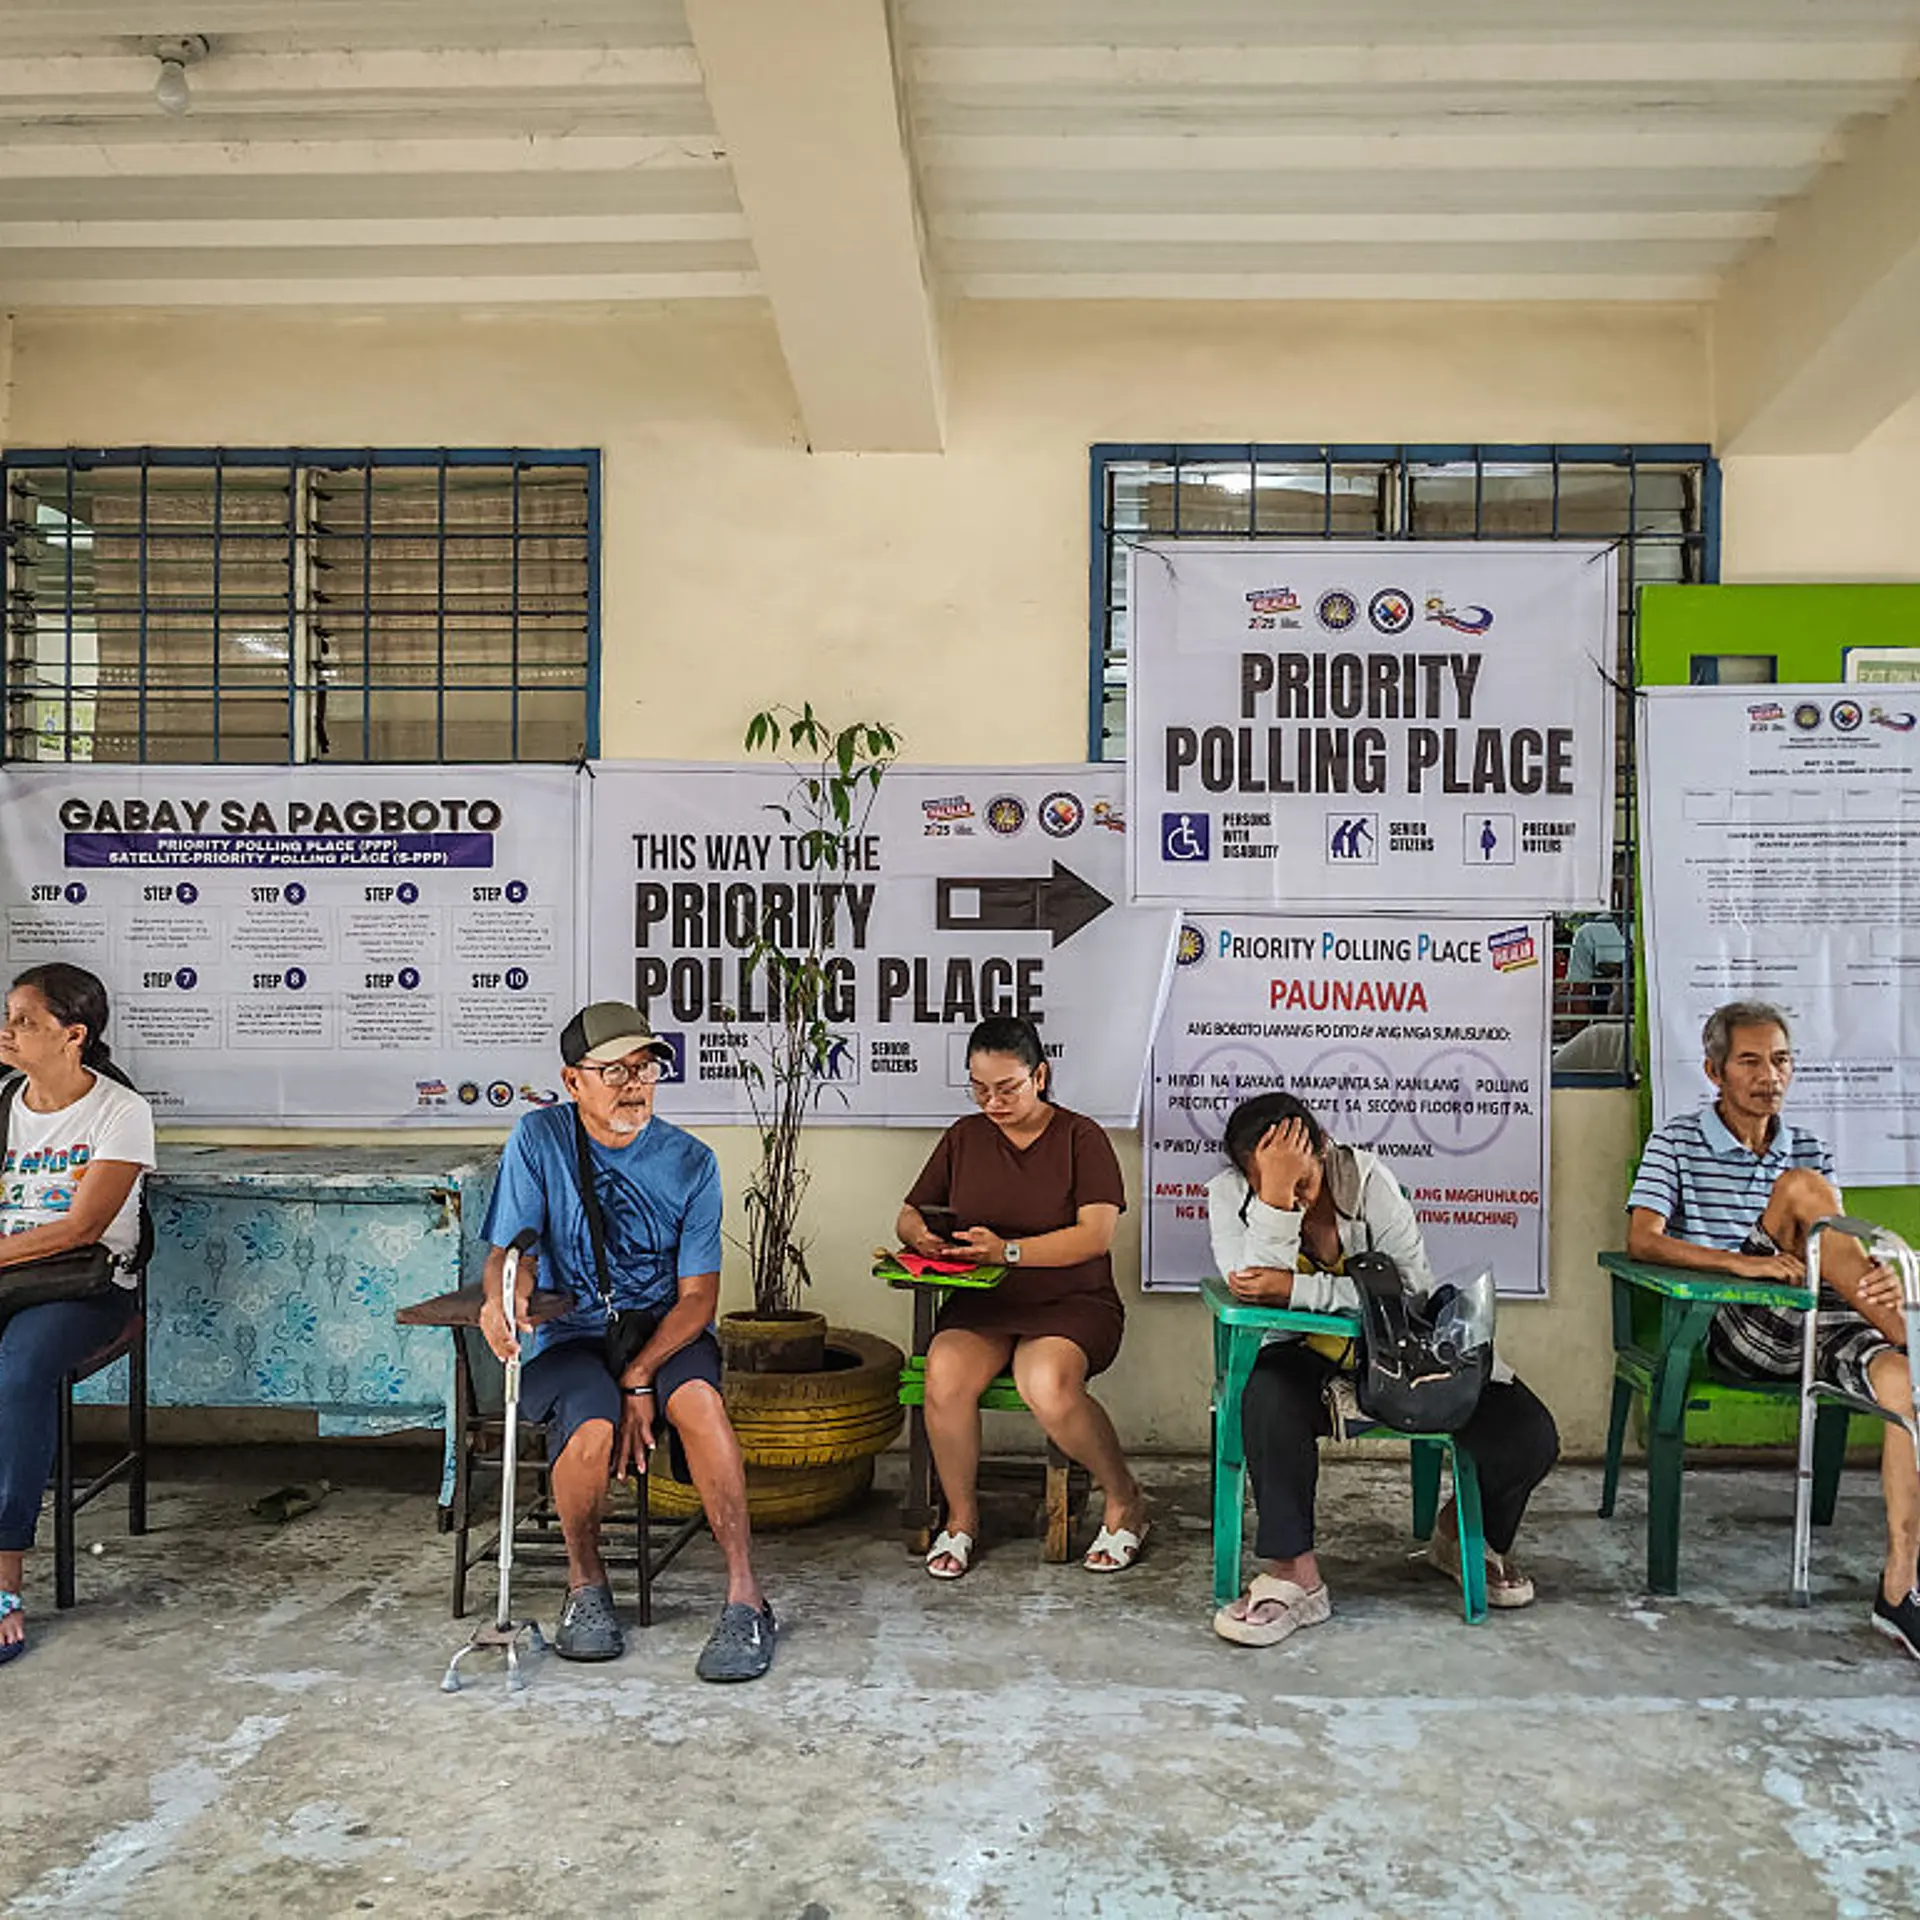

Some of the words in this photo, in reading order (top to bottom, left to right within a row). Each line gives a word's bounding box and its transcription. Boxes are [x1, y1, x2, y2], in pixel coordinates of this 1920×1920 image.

[1240, 653, 1481, 720] PRIORITY
[1165, 726, 1387, 794] POLLING
[1407, 727, 1574, 795] PLACE
[59, 798, 210, 832] GABAY
[220, 800, 278, 834] SA
[288, 799, 502, 834] PAGBOTO
[1222, 812, 1272, 826] PERSONS
[1222, 829, 1250, 843] WITH
[1389, 822, 1427, 836] SENIOR
[1522, 822, 1576, 836] PREGNANT
[157, 839, 229, 851] PRIORITY
[235, 839, 302, 851] POLLING
[305, 839, 354, 851] PLACE
[360, 839, 399, 852] (PPP)
[632, 833, 697, 870] THIS
[705, 834, 772, 871] WAY
[780, 835, 816, 871] TO
[834, 835, 881, 871] HE
[1222, 845, 1280, 859] DISABILITY
[1389, 838, 1434, 852] CITIZENS
[1522, 839, 1562, 853] VOTERS
[108, 852, 267, 864] SATELLITE-PRIORITY
[271, 852, 337, 864] POLLING
[341, 852, 389, 864] PLACE
[393, 851, 449, 866] (S-PPP)
[31, 884, 62, 901] STEP
[143, 885, 172, 901] STEP
[250, 887, 280, 902] STEP
[365, 887, 394, 902] STEP
[472, 886, 501, 901] STEP
[635, 882, 876, 949] PRIORITY
[1219, 929, 1316, 960] PRIORITY
[1322, 932, 1412, 962] POLLING
[1417, 933, 1482, 963] PLACE
[143, 972, 172, 989] STEP
[253, 973, 282, 989] STEP
[365, 973, 394, 989] STEP
[472, 973, 501, 988] STEP
[877, 956, 1046, 1023] PLACE
[1269, 978, 1429, 1013] PAUNAWA
[1186, 1022, 1212, 1036] ANG
[1215, 1022, 1261, 1037] BOBOTO
[1263, 1023, 1314, 1038] LAMANG
[1315, 1024, 1332, 1038] PO
[1333, 1024, 1359, 1038] DITO
[1360, 1025, 1374, 1038] AY
[1375, 1025, 1402, 1039] ANG
[1403, 1026, 1431, 1039] MGA
[700, 1032, 748, 1048] PERSONS
[699, 1049, 728, 1063] WITH
[871, 1042, 910, 1057] SENIOR
[871, 1058, 918, 1073] CITIZENS
[1168, 1074, 1205, 1087] HINDI
[1211, 1074, 1229, 1088] NA
[1236, 1075, 1284, 1089] KAYANG
[1291, 1076, 1371, 1090] MAKAPUNTA
[1373, 1077, 1389, 1090] SA
[1395, 1077, 1460, 1092] KANILANG
[1475, 1079, 1529, 1093] POLLING
[1168, 1096, 1229, 1111] PRECINCT
[1346, 1100, 1362, 1113] SA
[1368, 1100, 1417, 1114] SECOND
[1421, 1101, 1463, 1114] FLOOR
[1464, 1102, 1474, 1113] O
[1477, 1102, 1511, 1115] HIGIT
[1513, 1102, 1534, 1116] PA.
[1378, 1143, 1435, 1157] WOMAN.
[1155, 1183, 1182, 1198] ANG
[1414, 1188, 1441, 1201] ANG
[1445, 1189, 1539, 1204] MAGHUHULOG
[1176, 1205, 1197, 1219] NG
[1453, 1211, 1520, 1229] MACHINE)
